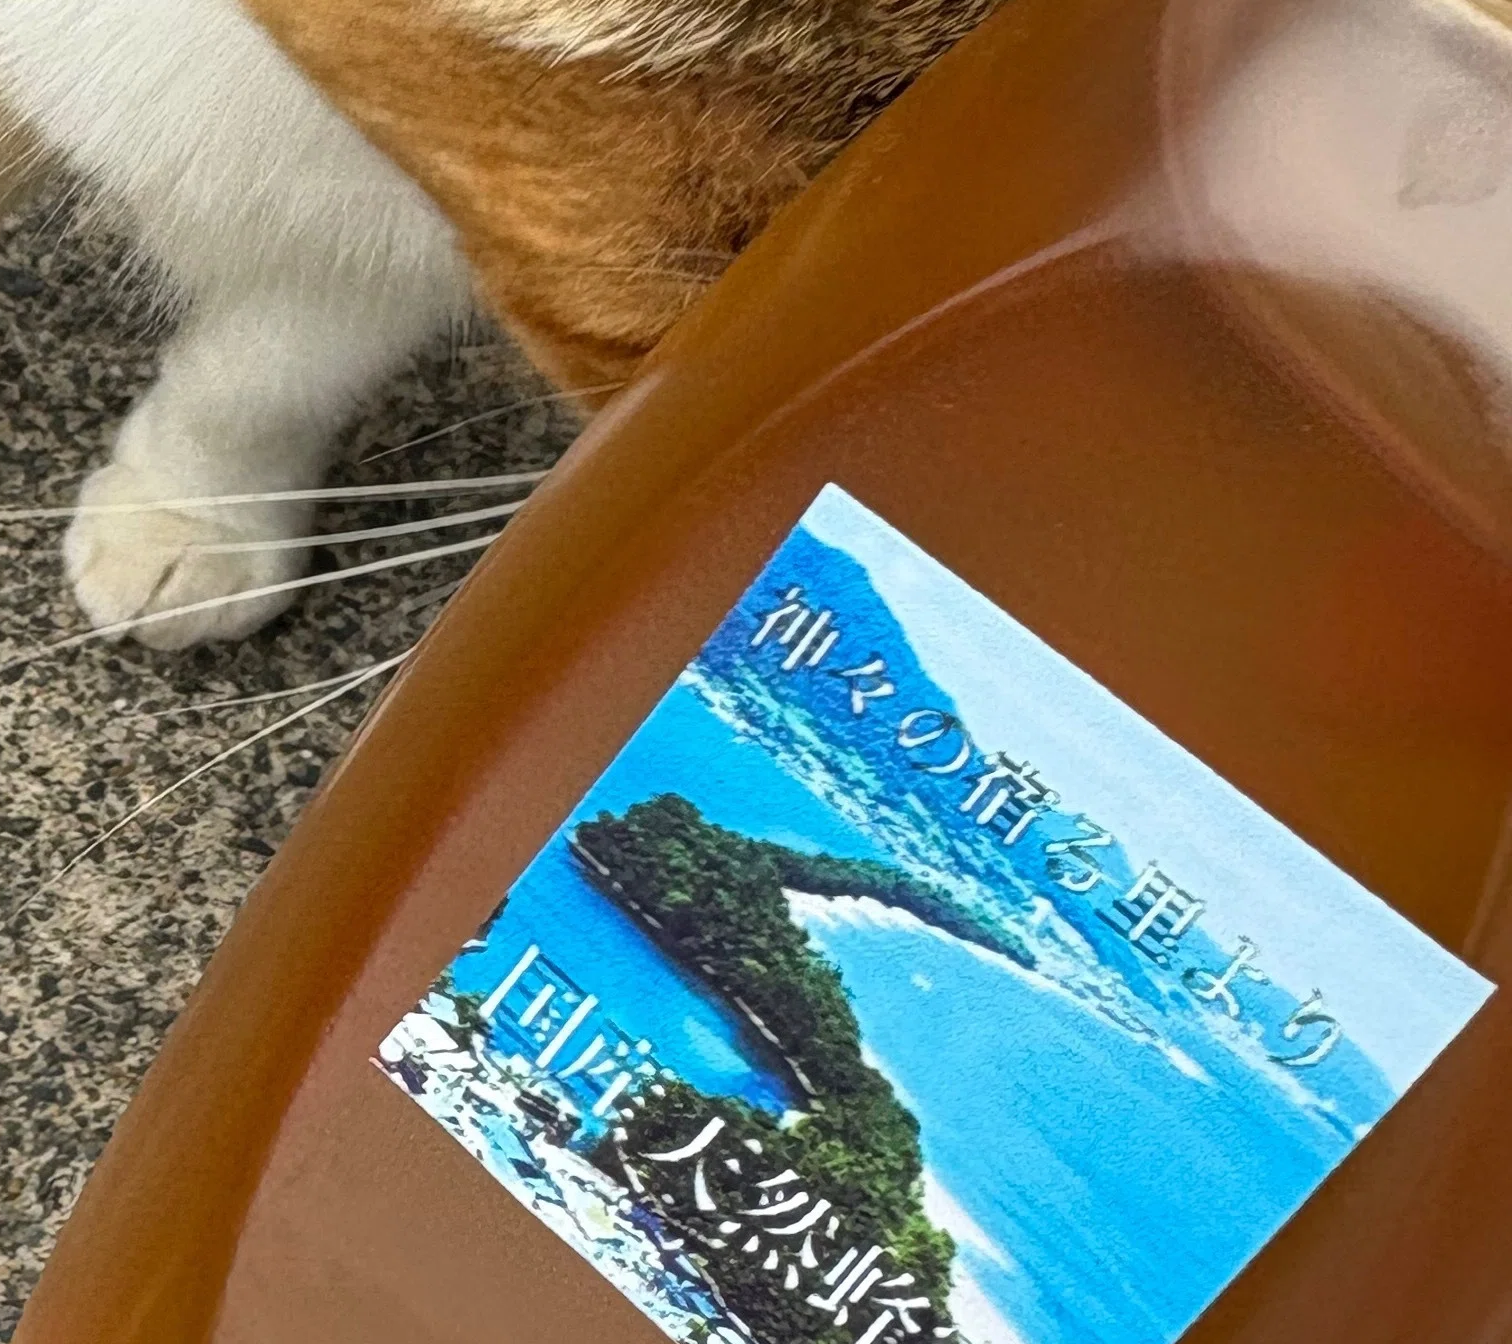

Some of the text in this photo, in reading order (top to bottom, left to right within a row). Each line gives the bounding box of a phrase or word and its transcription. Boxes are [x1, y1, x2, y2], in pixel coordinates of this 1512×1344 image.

[750, 586, 1344, 1068] 神々の宿る里より
